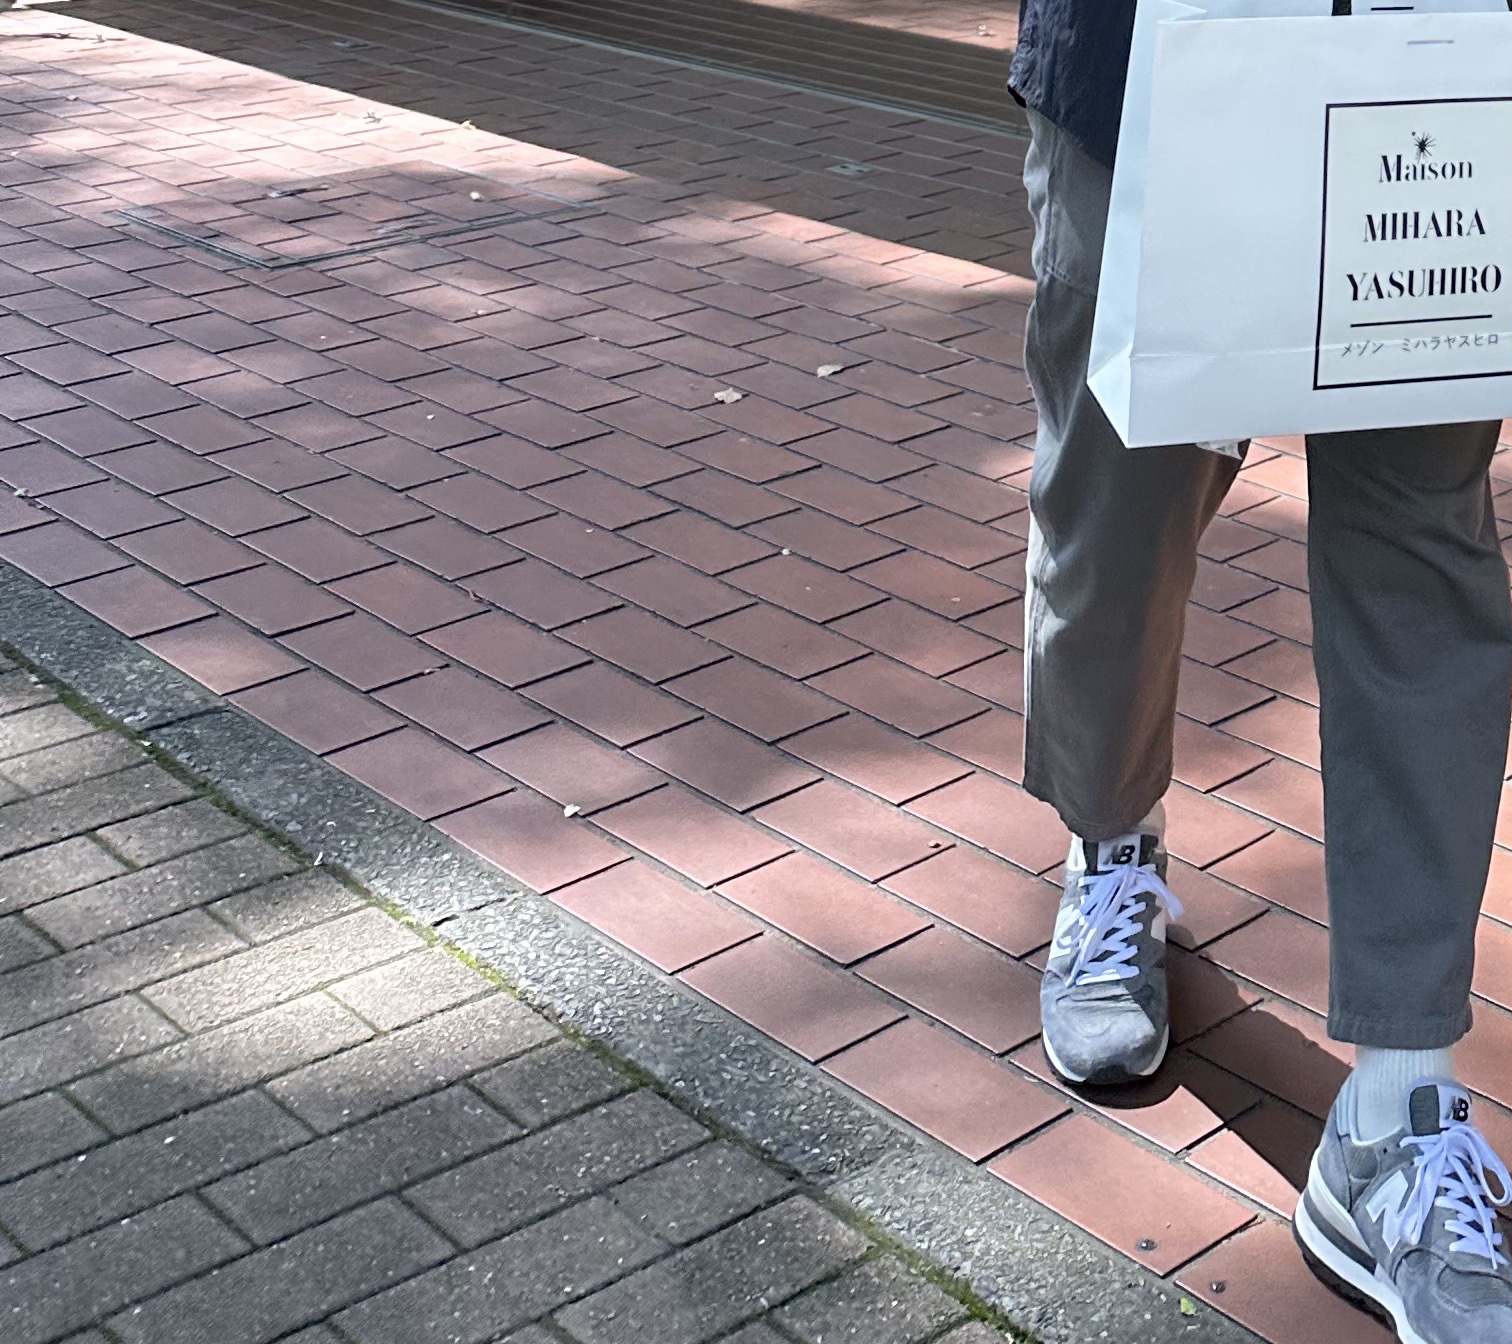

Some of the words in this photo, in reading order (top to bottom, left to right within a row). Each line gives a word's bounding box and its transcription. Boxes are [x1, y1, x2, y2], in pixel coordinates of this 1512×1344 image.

[1378, 153, 1473, 184] Maison
[1363, 208, 1486, 242] MIHARA
[1345, 264, 1503, 302] YASUHIRO
[1400, 333, 1500, 353] ミハラヤスヒロ
